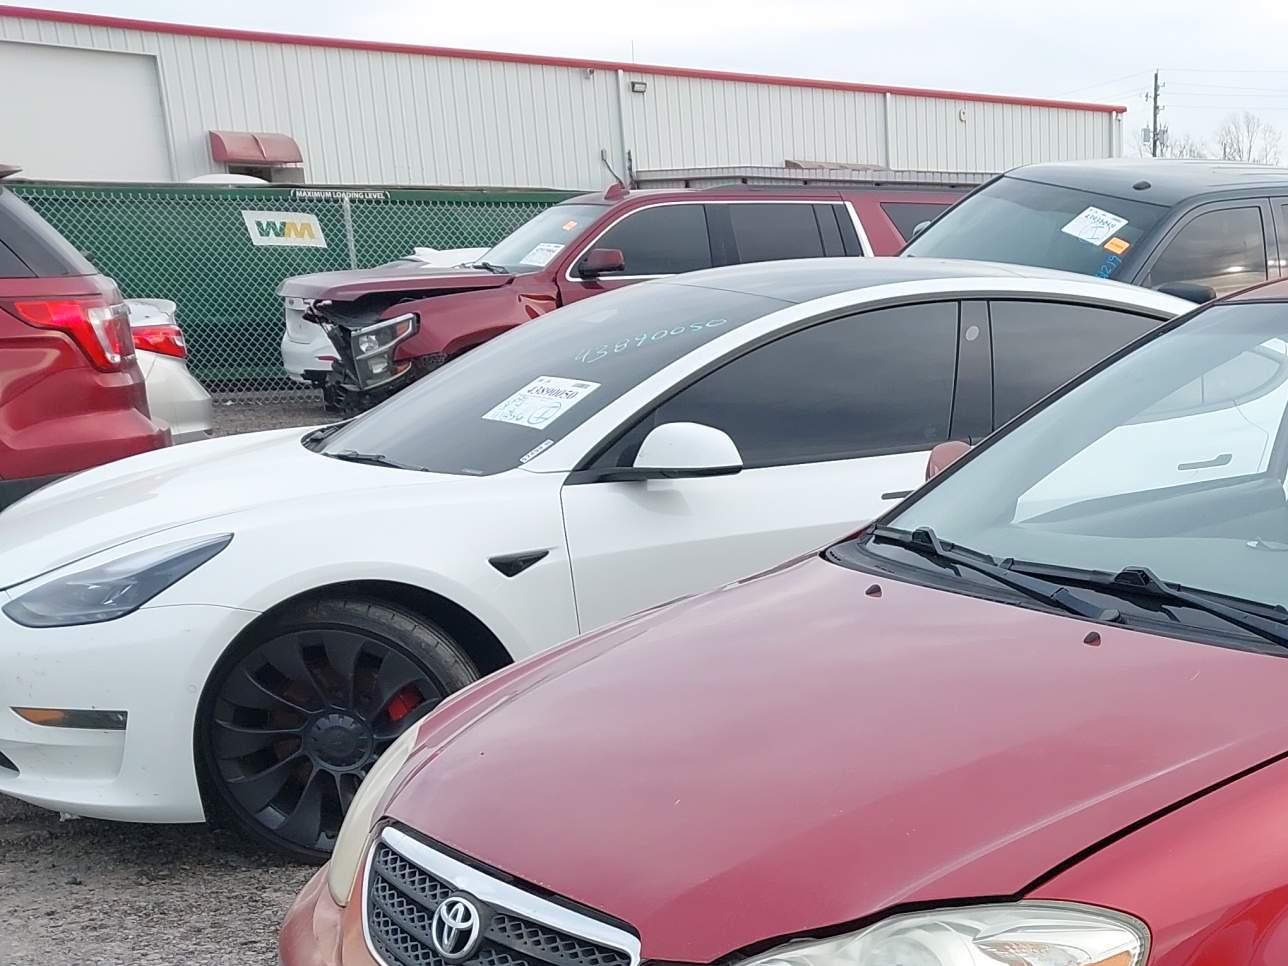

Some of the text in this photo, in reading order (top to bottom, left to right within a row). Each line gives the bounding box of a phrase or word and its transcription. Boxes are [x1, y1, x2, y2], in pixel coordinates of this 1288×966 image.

[295, 190, 386, 200] MAXIMUM LOADING LEVEL
[254, 219, 316, 240] WM
